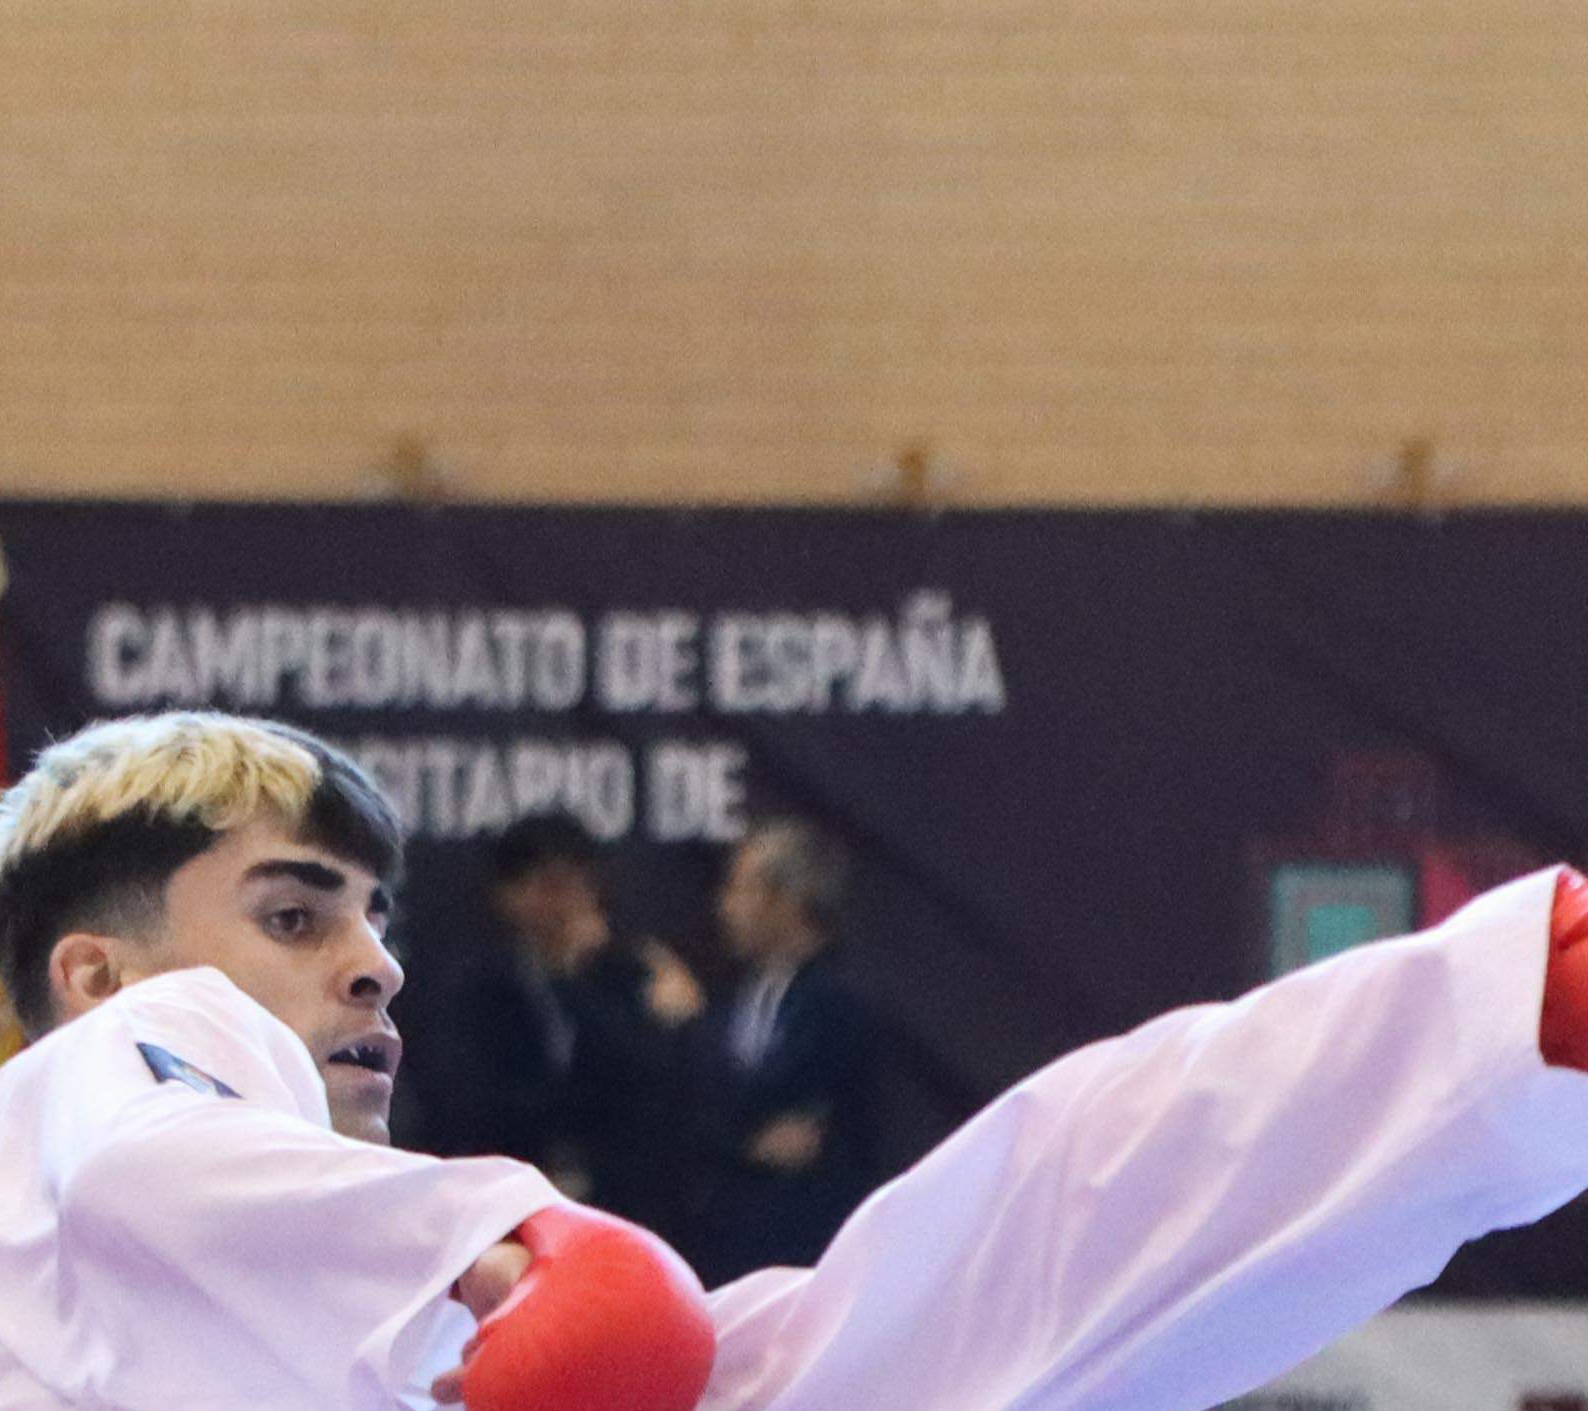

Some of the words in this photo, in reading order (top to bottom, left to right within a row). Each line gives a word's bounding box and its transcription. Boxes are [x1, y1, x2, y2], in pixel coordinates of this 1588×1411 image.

[86, 605, 587, 710] CAMPEONATO
[597, 611, 700, 712] DE
[714, 590, 1007, 713] ESPAÑA
[647, 741, 749, 841] DE
